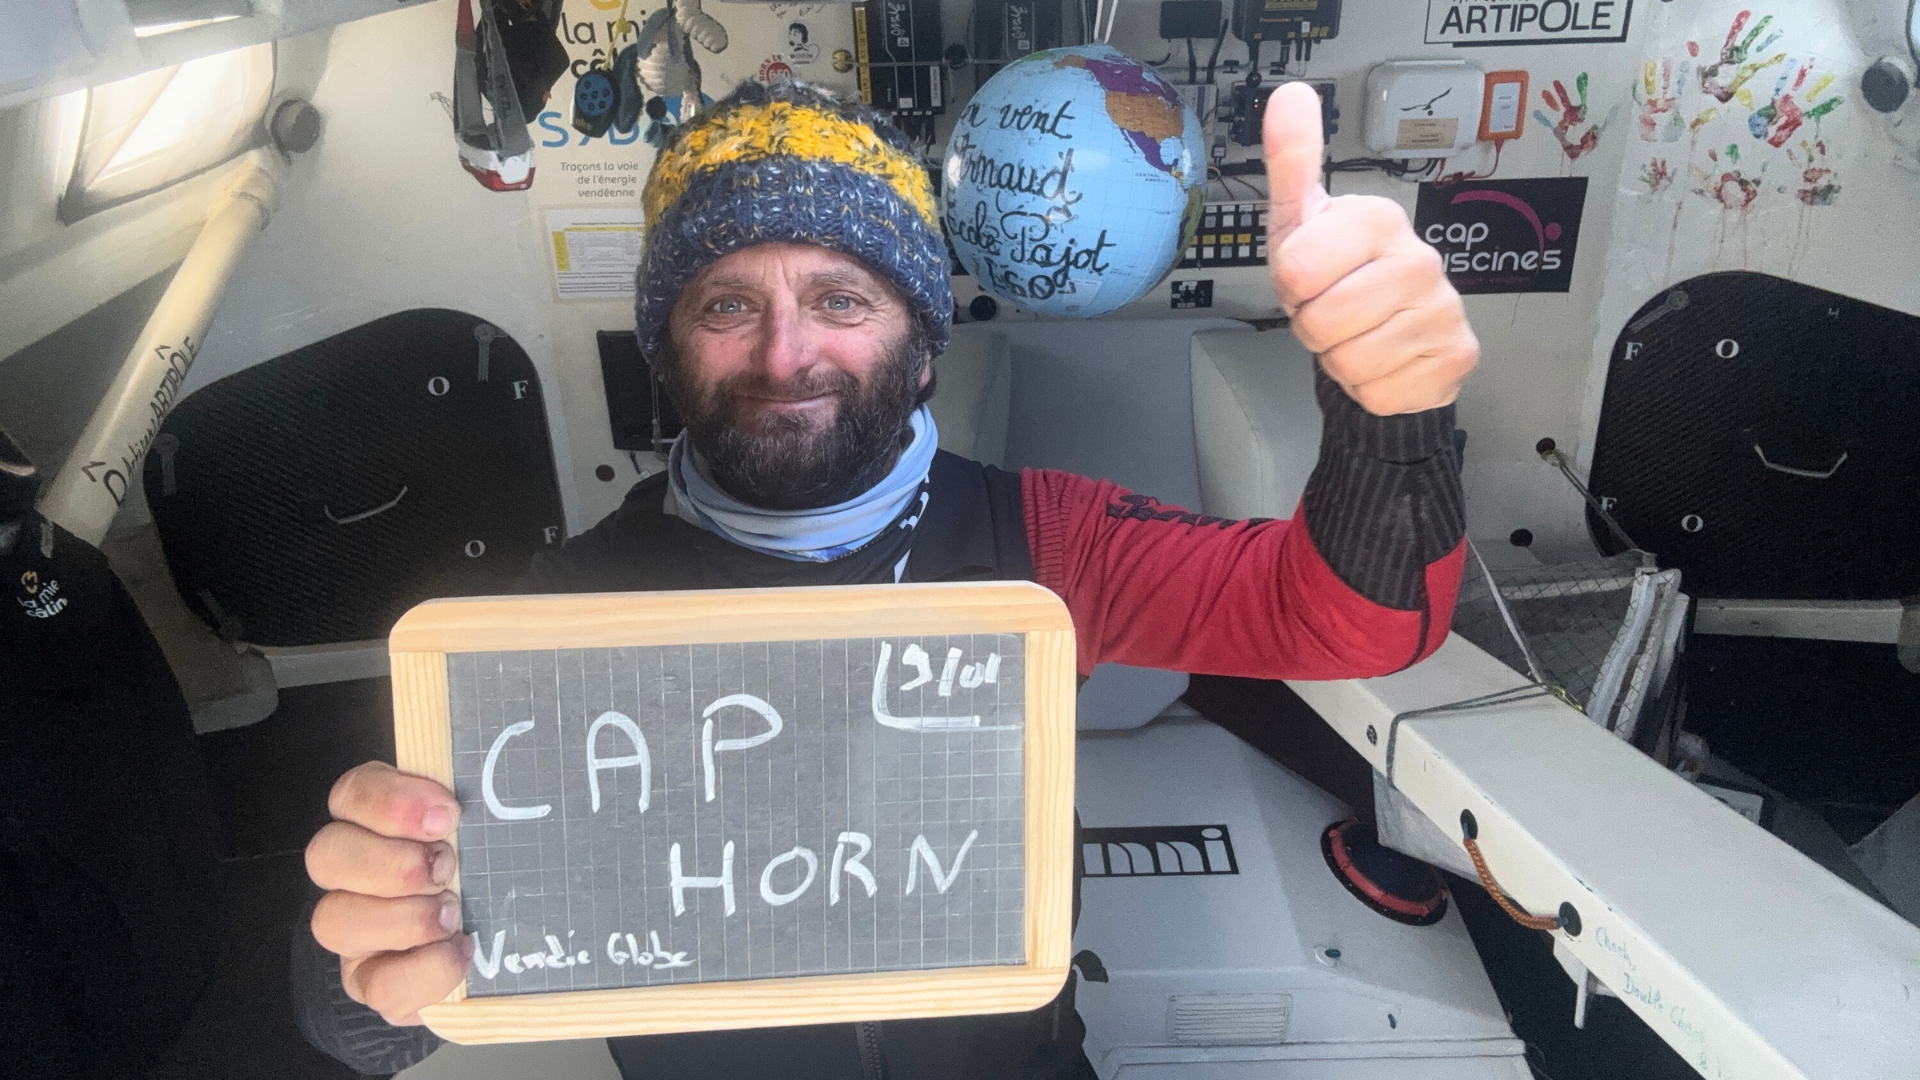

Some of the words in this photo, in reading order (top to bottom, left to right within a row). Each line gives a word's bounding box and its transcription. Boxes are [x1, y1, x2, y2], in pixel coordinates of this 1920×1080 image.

[561, 12, 597, 44] la
[999, 100, 1076, 139] vent
[560, 162, 601, 173] Traçons
[604, 162, 614, 171] la
[617, 161, 639, 171] voie
[577, 175, 590, 184] de
[593, 175, 637, 186] l'énergie
[578, 188, 635, 197] vendéenne
[1425, 222, 1489, 251] cap
[1001, 210, 1116, 288] Pajot
[1443, 245, 1561, 272] iscines
[1623, 341, 1643, 361] F
[1715, 338, 1739, 358] O
[427, 376, 450, 396] O
[512, 380, 529, 400] F
[1681, 514, 1704, 533] O
[542, 525, 558, 545] F
[464, 539, 486, 558] O
[38, 580, 59, 604] mie
[481, 693, 784, 821] CAP
[669, 829, 979, 918] HORN
[606, 929, 698, 970] Globe
